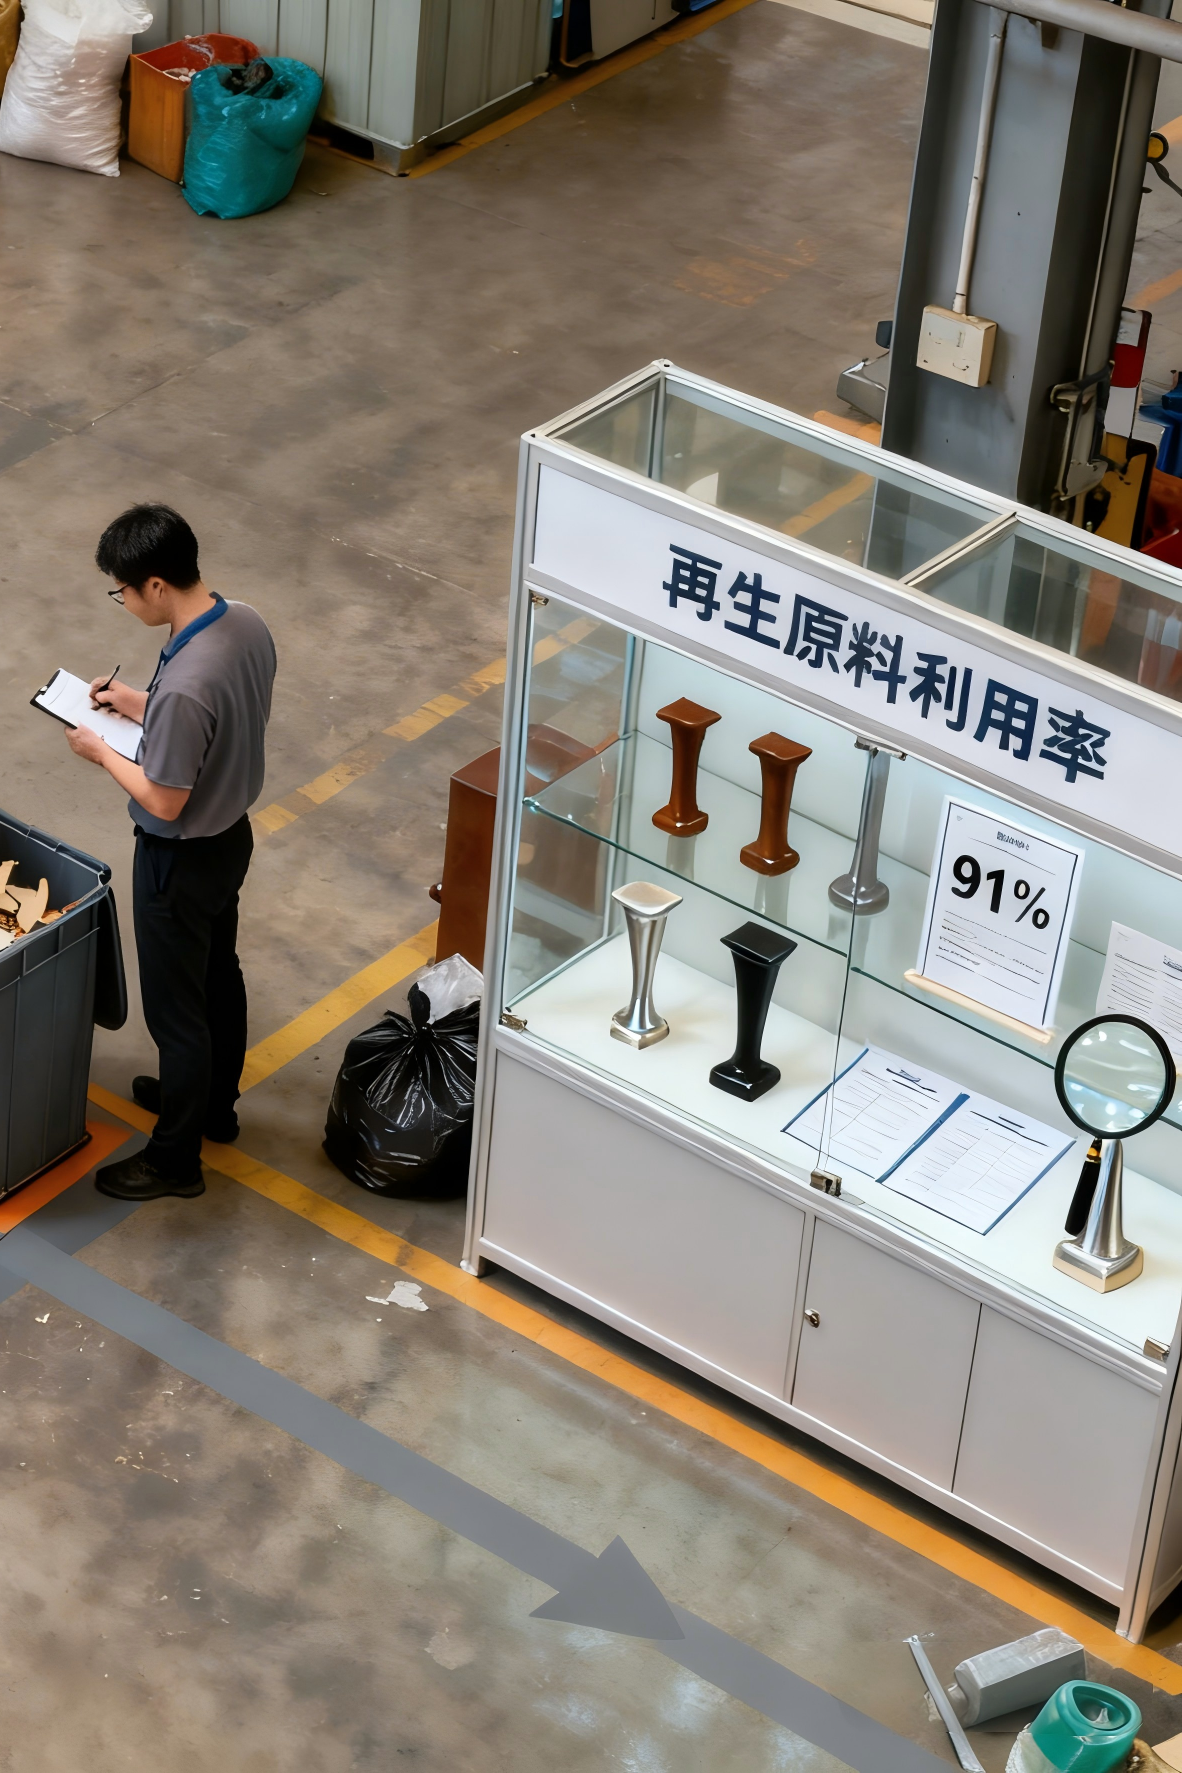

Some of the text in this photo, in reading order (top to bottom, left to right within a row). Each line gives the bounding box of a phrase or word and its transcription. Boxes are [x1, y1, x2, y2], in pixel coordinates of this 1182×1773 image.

[662, 543, 1111, 784] 再生原料利用率
[951, 855, 1050, 930] 91%
